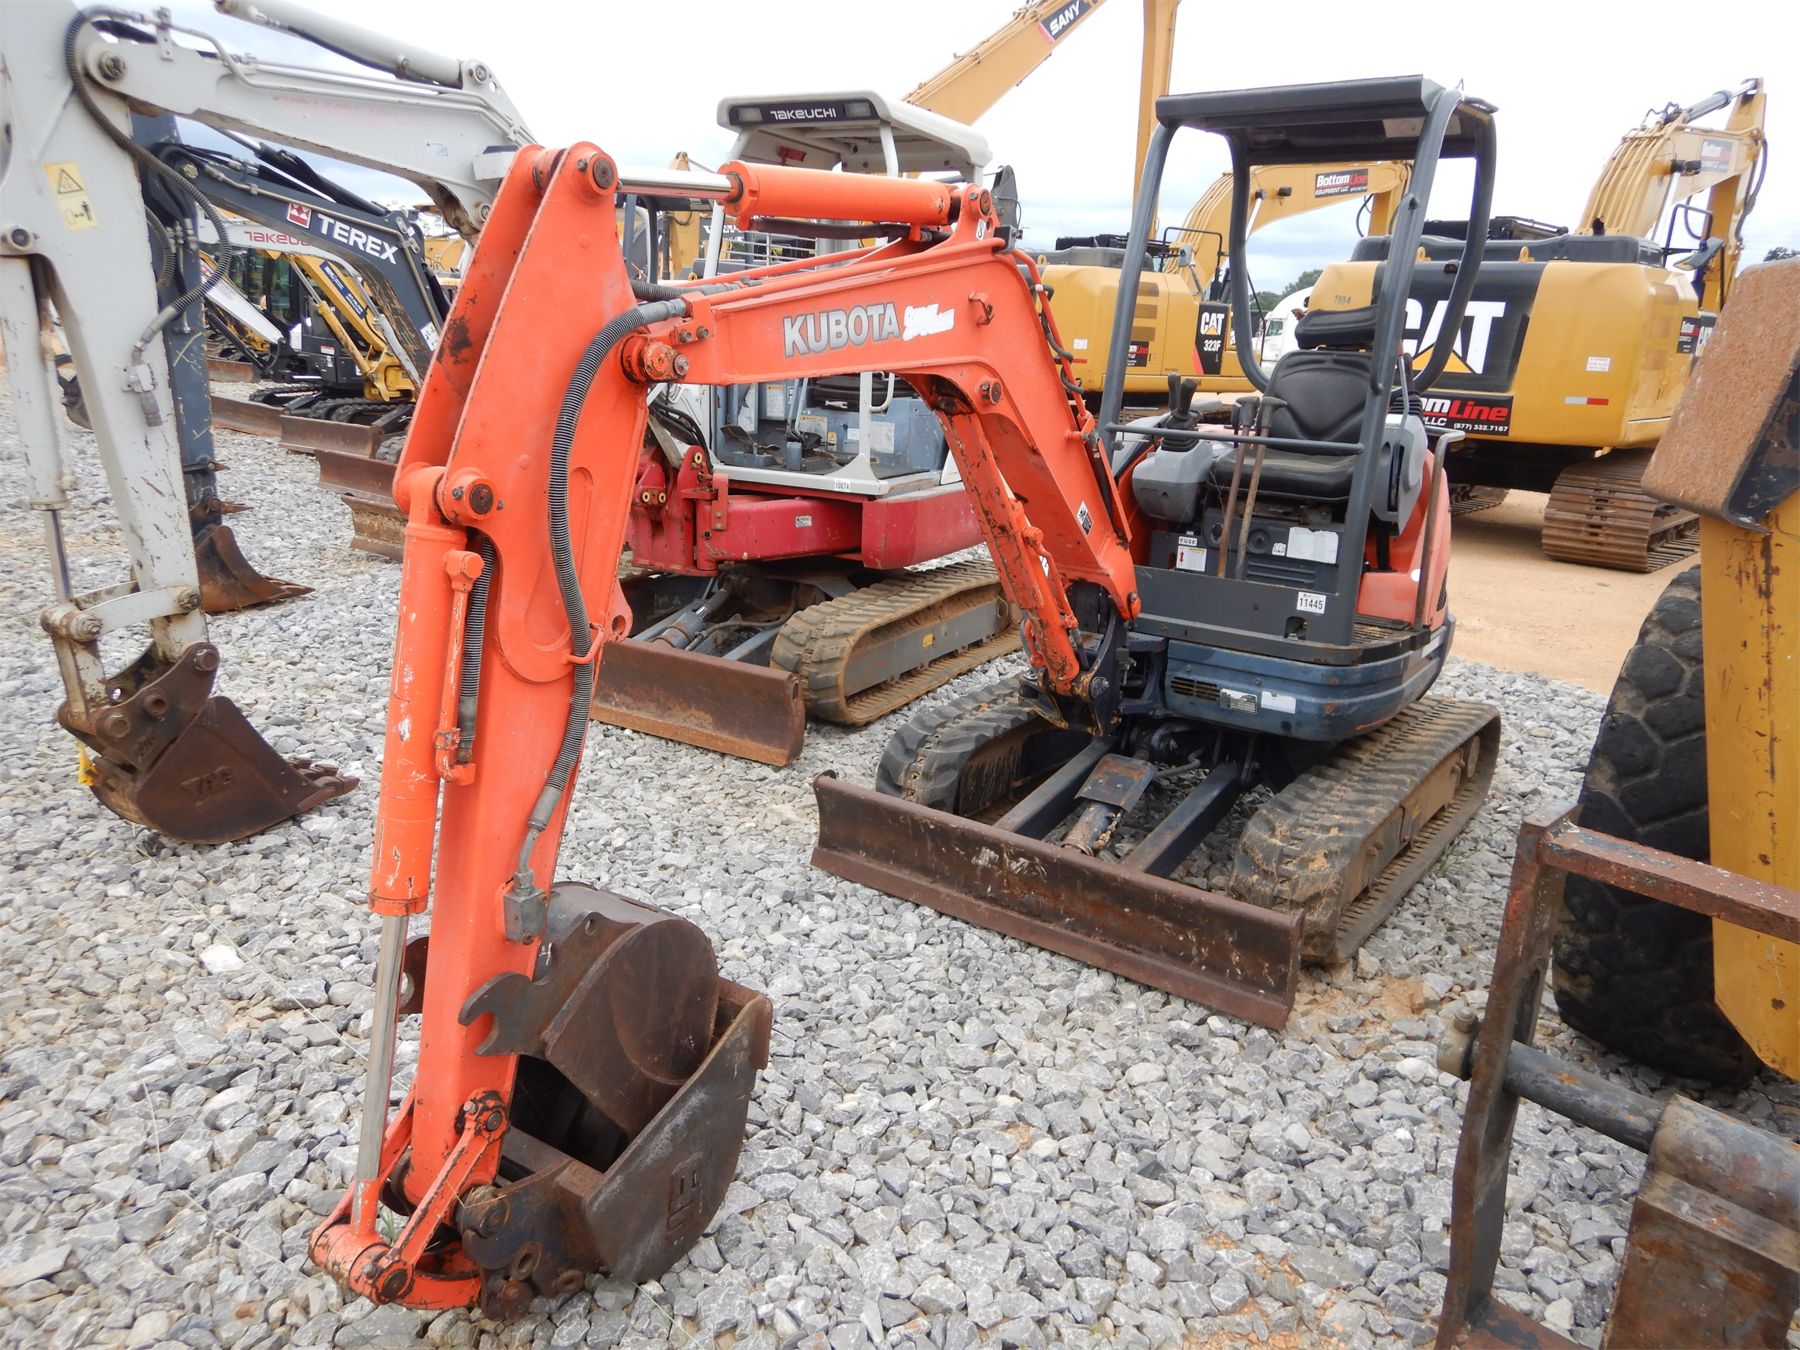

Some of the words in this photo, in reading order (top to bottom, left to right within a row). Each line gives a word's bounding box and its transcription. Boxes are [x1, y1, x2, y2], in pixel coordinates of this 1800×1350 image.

[1050, 0, 1080, 36] SANY
[770, 108, 837, 120] TAKEUCHI
[318, 213, 398, 265] TEREX
[783, 302, 900, 358] KUBOTA
[1200, 312, 1225, 336] CAT
[1203, 340, 1221, 352] 323F
[1453, 422, 1472, 431] (877)
[1299, 597, 1324, 611] 11445
